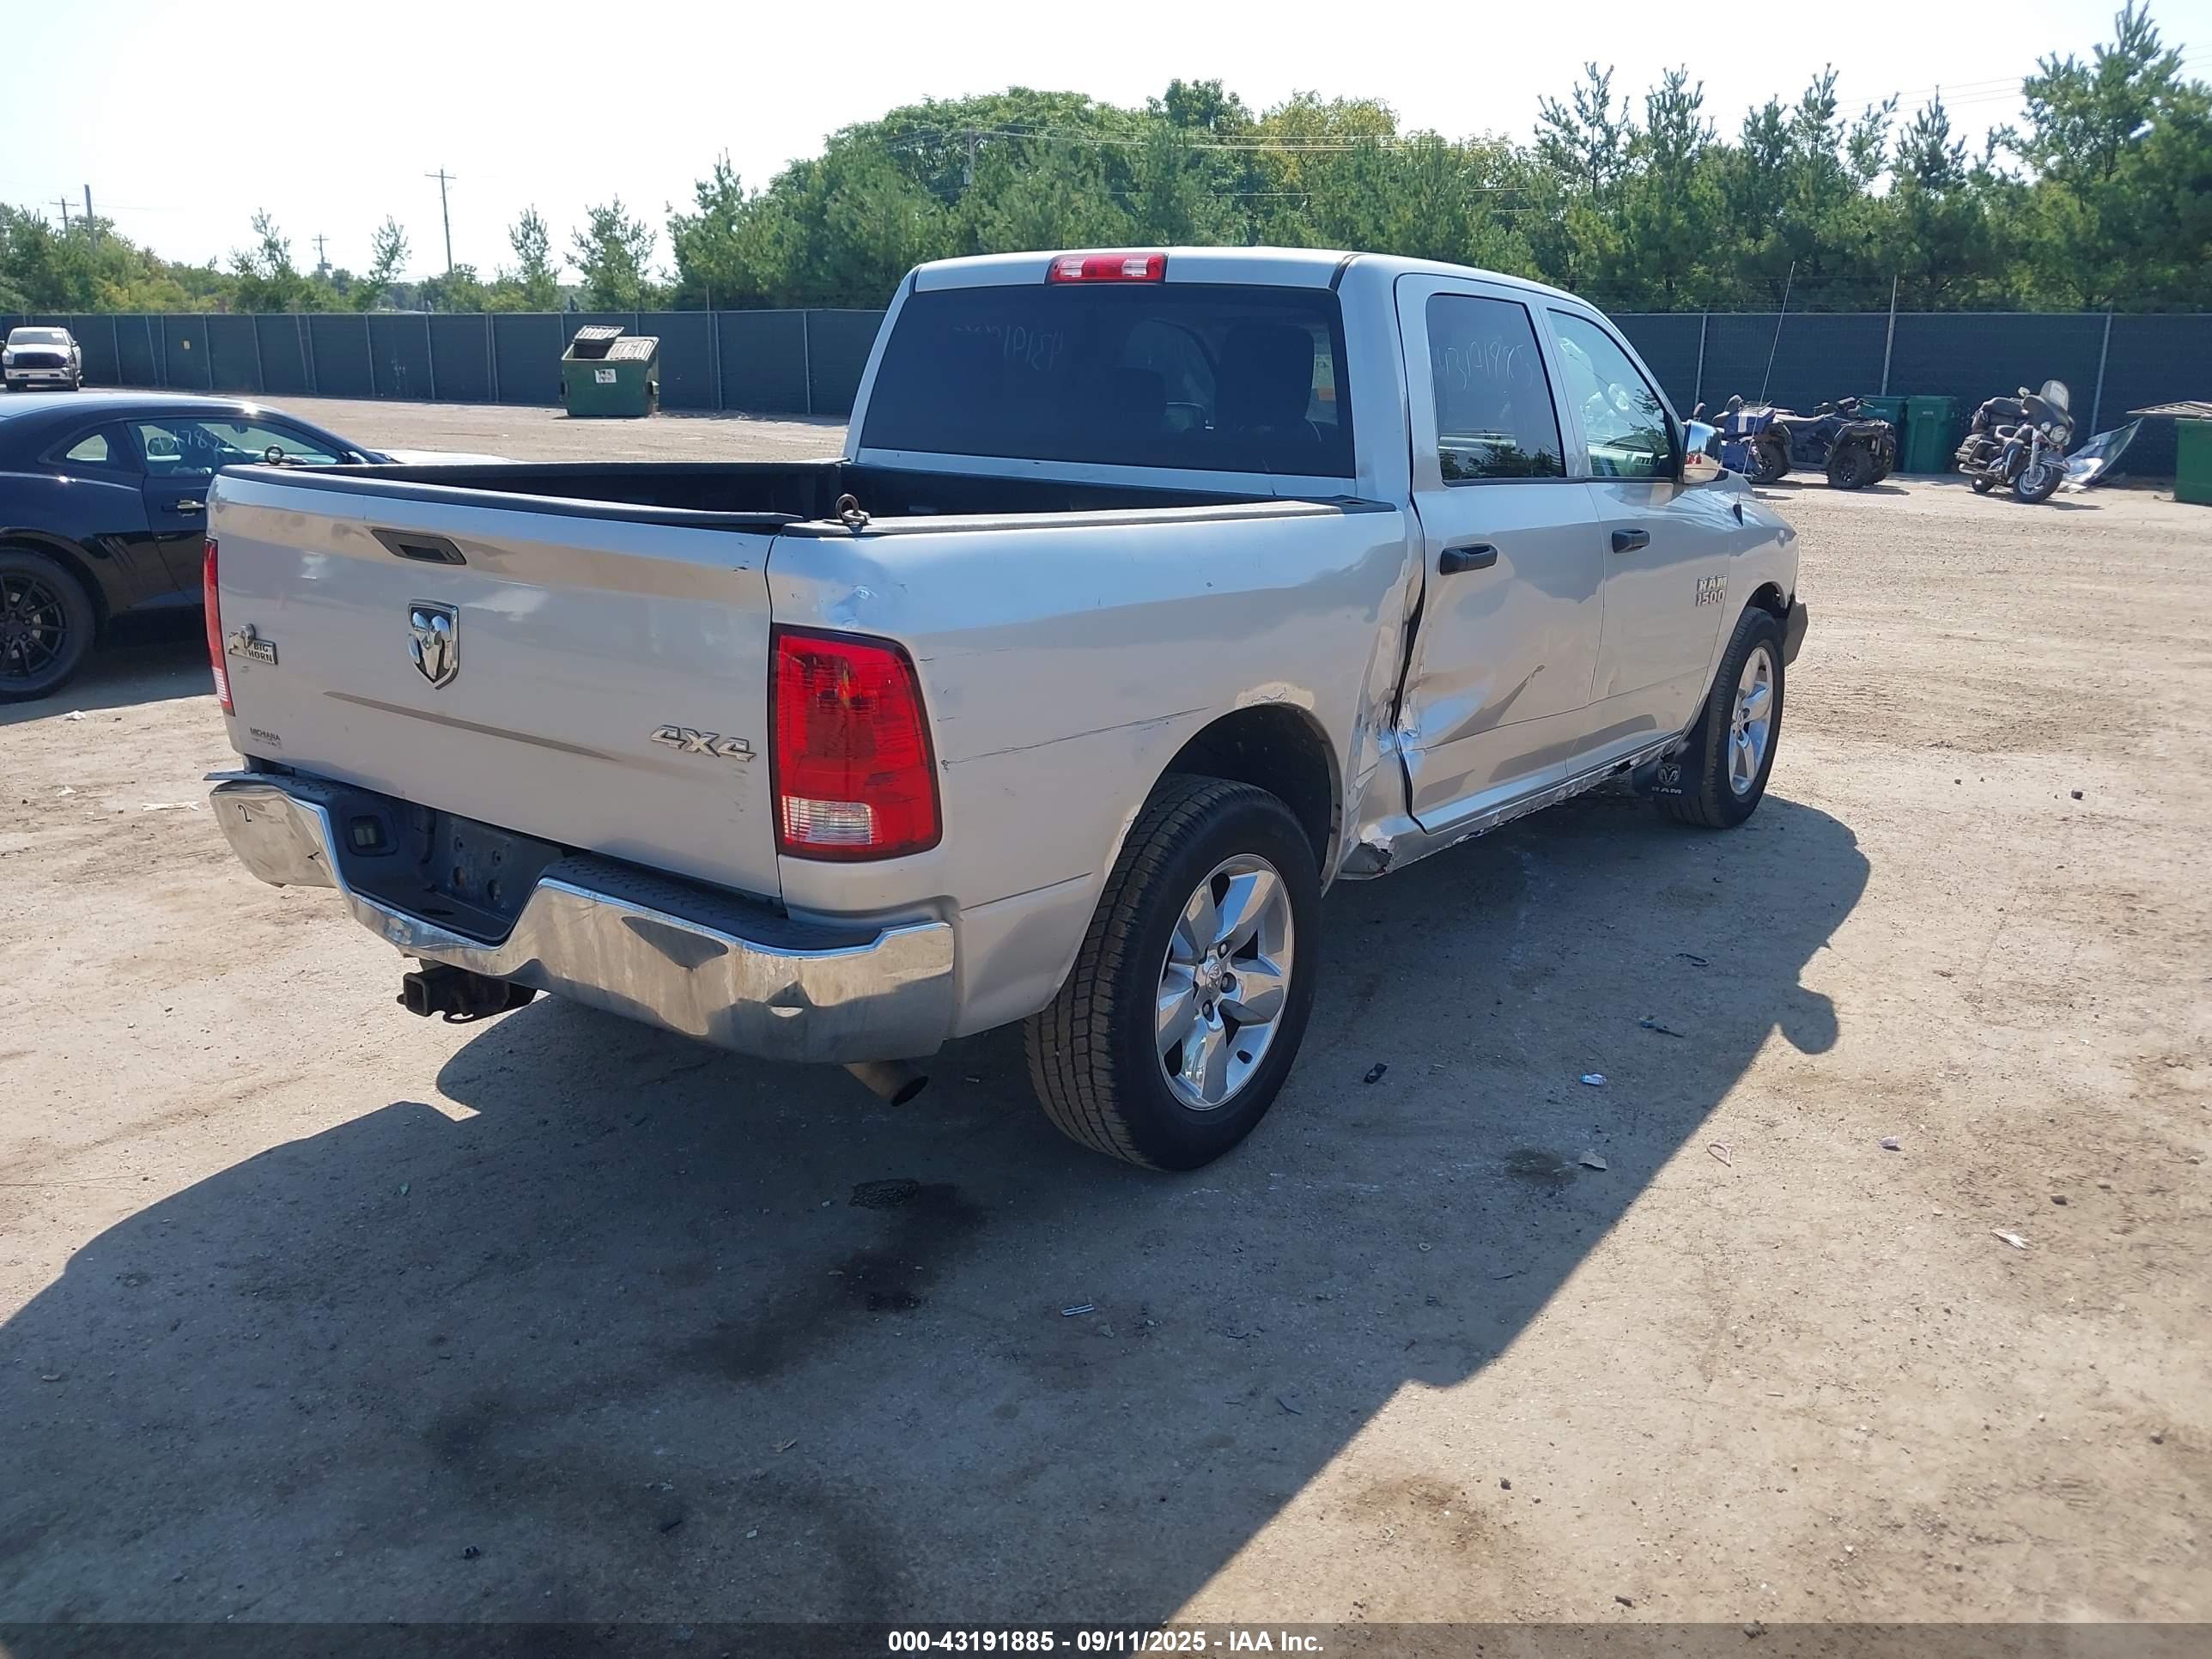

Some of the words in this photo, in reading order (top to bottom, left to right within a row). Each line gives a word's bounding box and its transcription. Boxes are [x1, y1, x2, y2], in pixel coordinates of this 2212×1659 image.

[1697, 574, 1728, 592] RAM
[1695, 589, 1726, 606] 1500
[248, 649, 273, 662] HORN
[254, 641, 271, 653] BIG
[651, 724, 757, 763] 4X4
